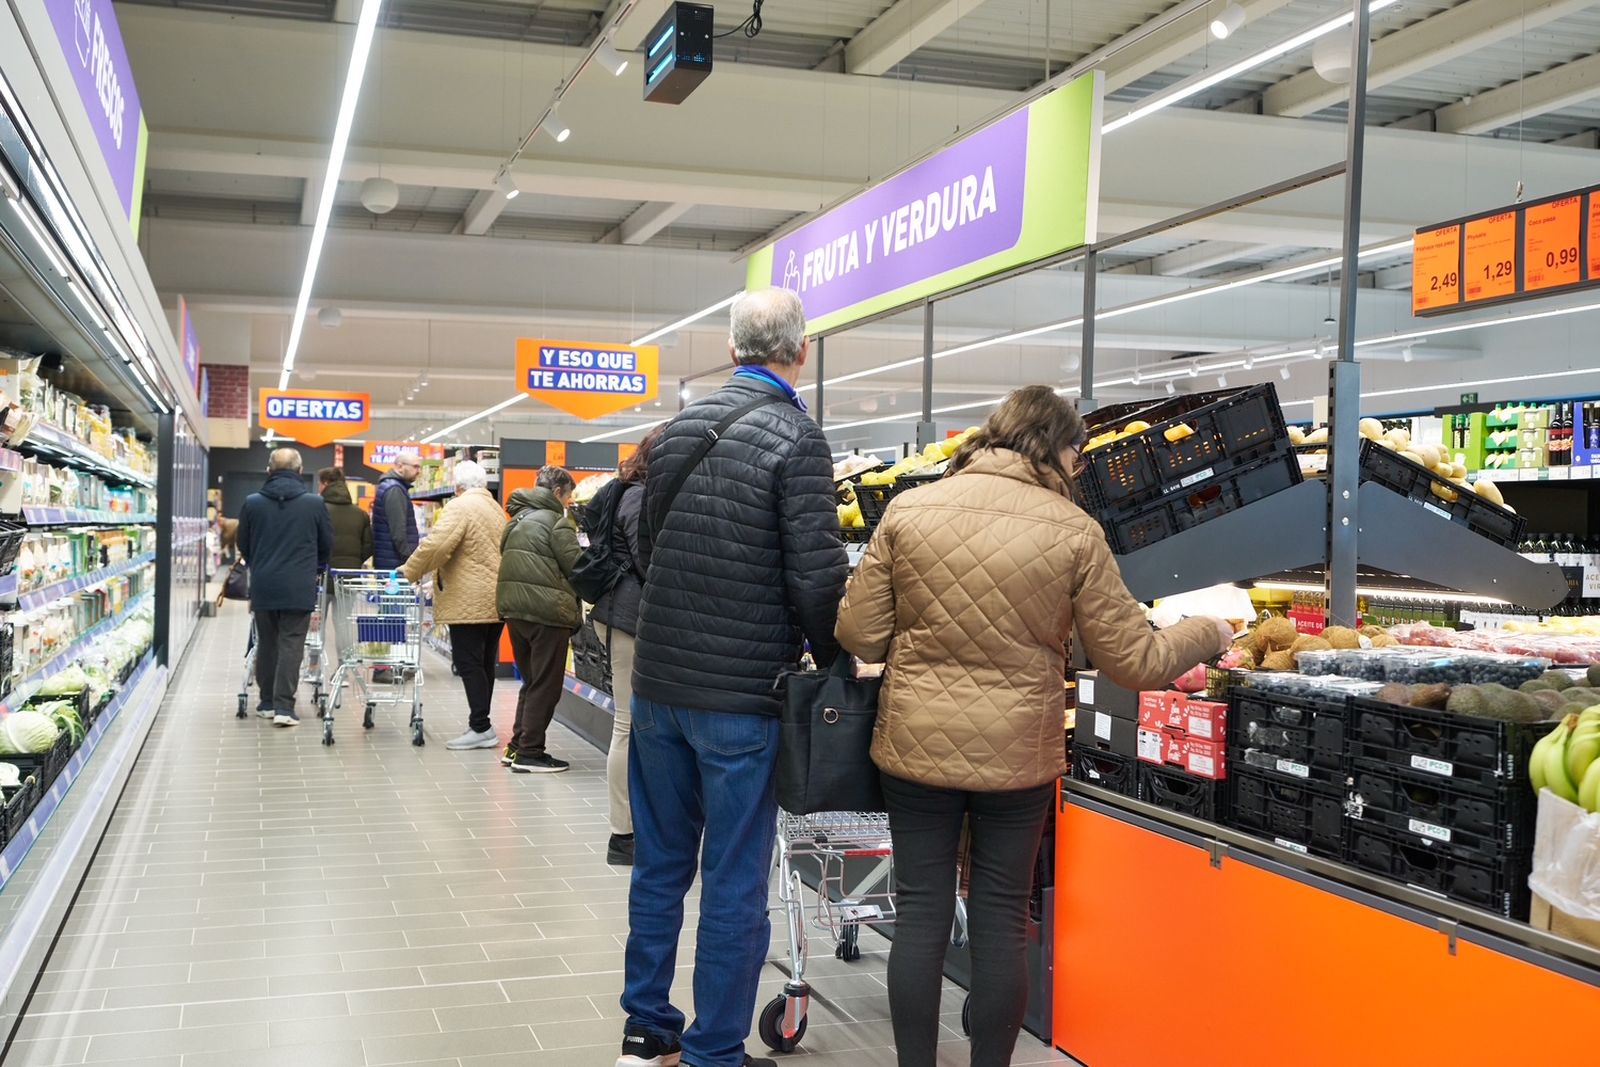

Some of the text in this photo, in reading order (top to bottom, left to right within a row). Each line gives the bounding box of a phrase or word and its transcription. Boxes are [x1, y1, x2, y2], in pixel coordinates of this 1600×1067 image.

[91, 11, 125, 150] FRESCOS
[1552, 198, 1578, 209] OFERTA
[802, 165, 997, 292] FRUTA Y VERDURA
[1488, 213, 1513, 224] OFERTA
[1435, 227, 1457, 237] OFERTA
[1546, 247, 1578, 269] 0,99
[1483, 260, 1513, 281] 1,29
[1431, 272, 1457, 292] 2,49
[541, 349, 634, 370] Y ESO QUE
[530, 370, 644, 392] TE AHORRAS
[267, 398, 363, 420] OFERTAS
[626, 1035, 645, 1044] PUMA
